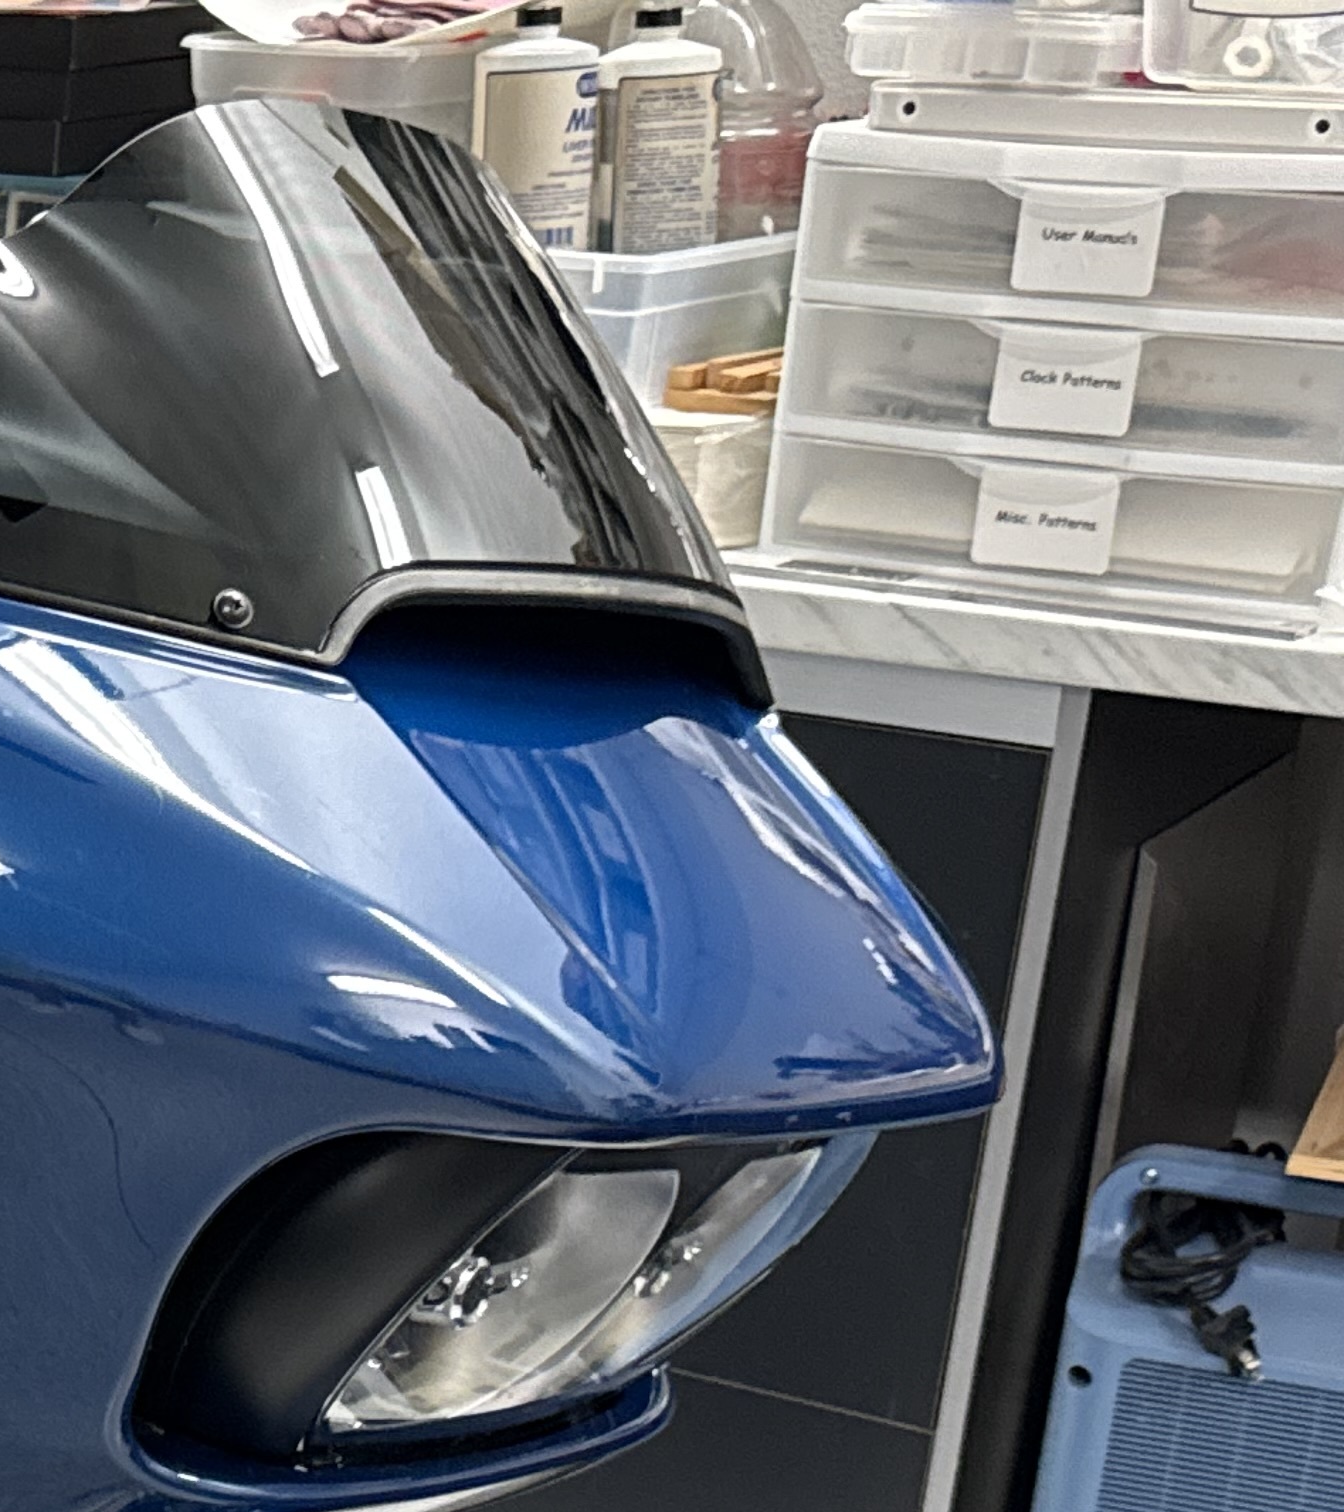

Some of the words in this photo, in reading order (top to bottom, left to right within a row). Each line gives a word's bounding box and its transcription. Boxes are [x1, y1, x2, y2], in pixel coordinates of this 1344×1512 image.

[1041, 227, 1077, 241] User
[1082, 229, 1138, 245] Manuals
[1020, 369, 1058, 384] Clock
[1062, 371, 1122, 391] Patterns
[1037, 512, 1097, 532] Patterns
